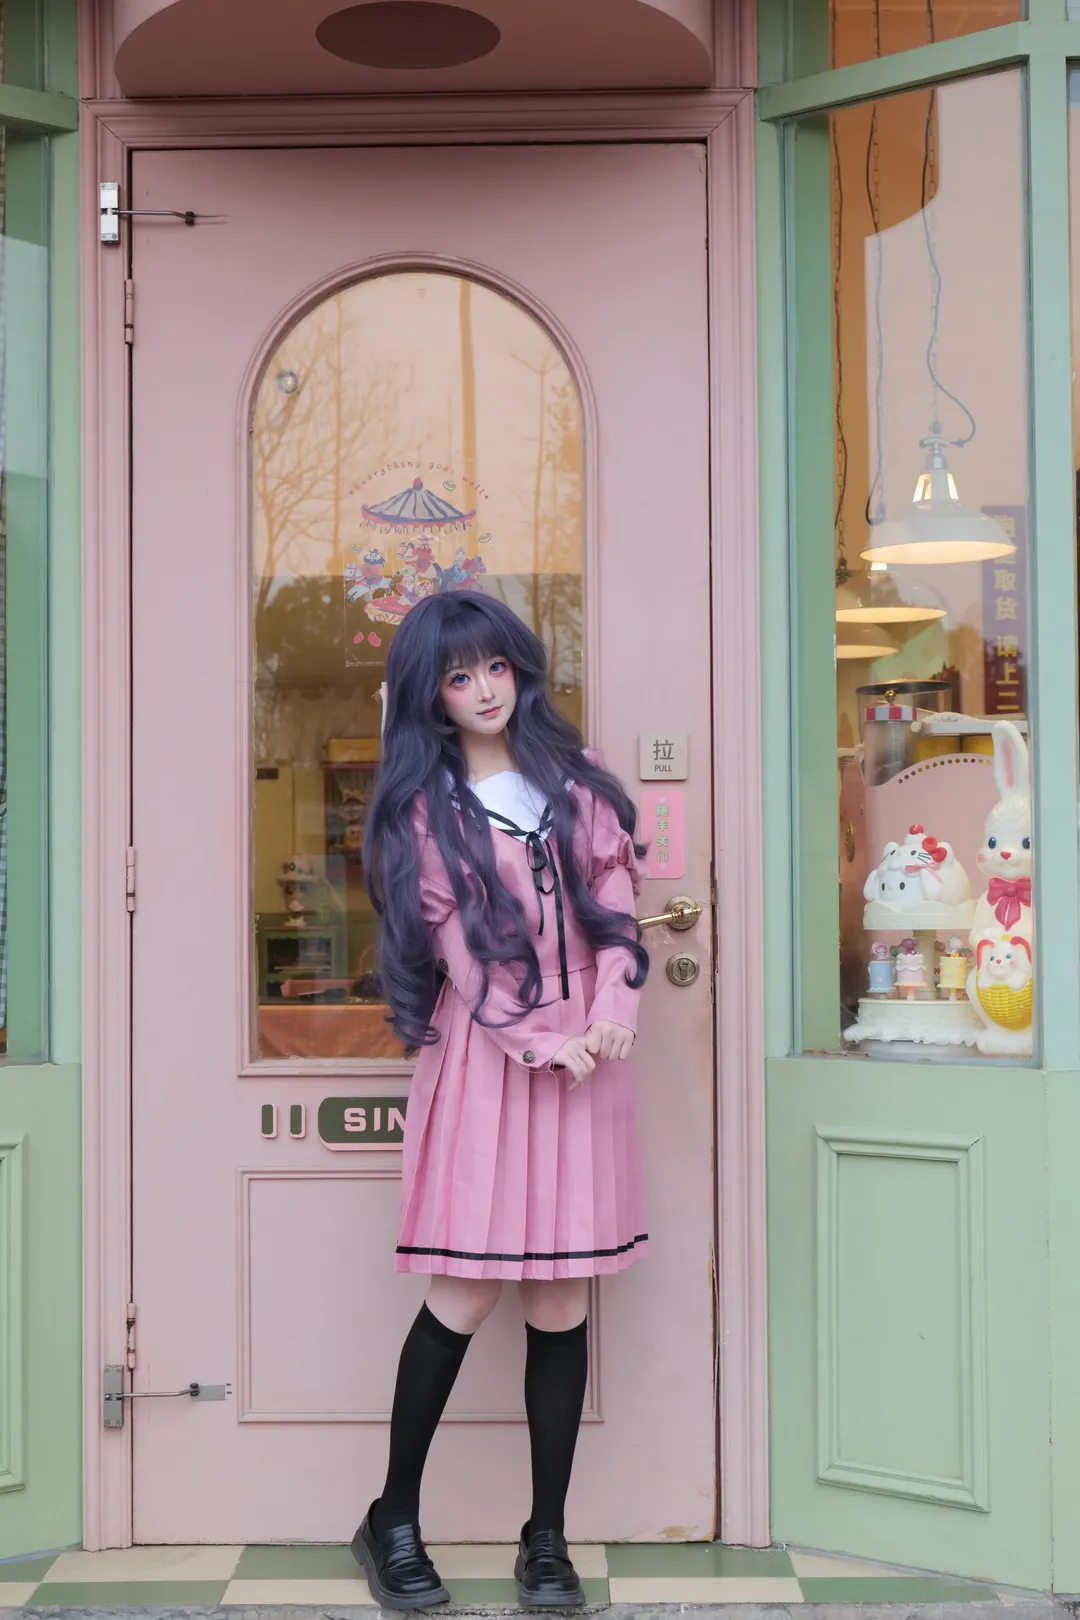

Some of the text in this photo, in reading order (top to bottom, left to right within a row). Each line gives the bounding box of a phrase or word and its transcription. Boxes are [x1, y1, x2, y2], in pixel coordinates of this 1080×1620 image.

[653, 739, 674, 760] 拉
[654, 764, 672, 772] PULL
[656, 804, 669, 863] 随手关门
